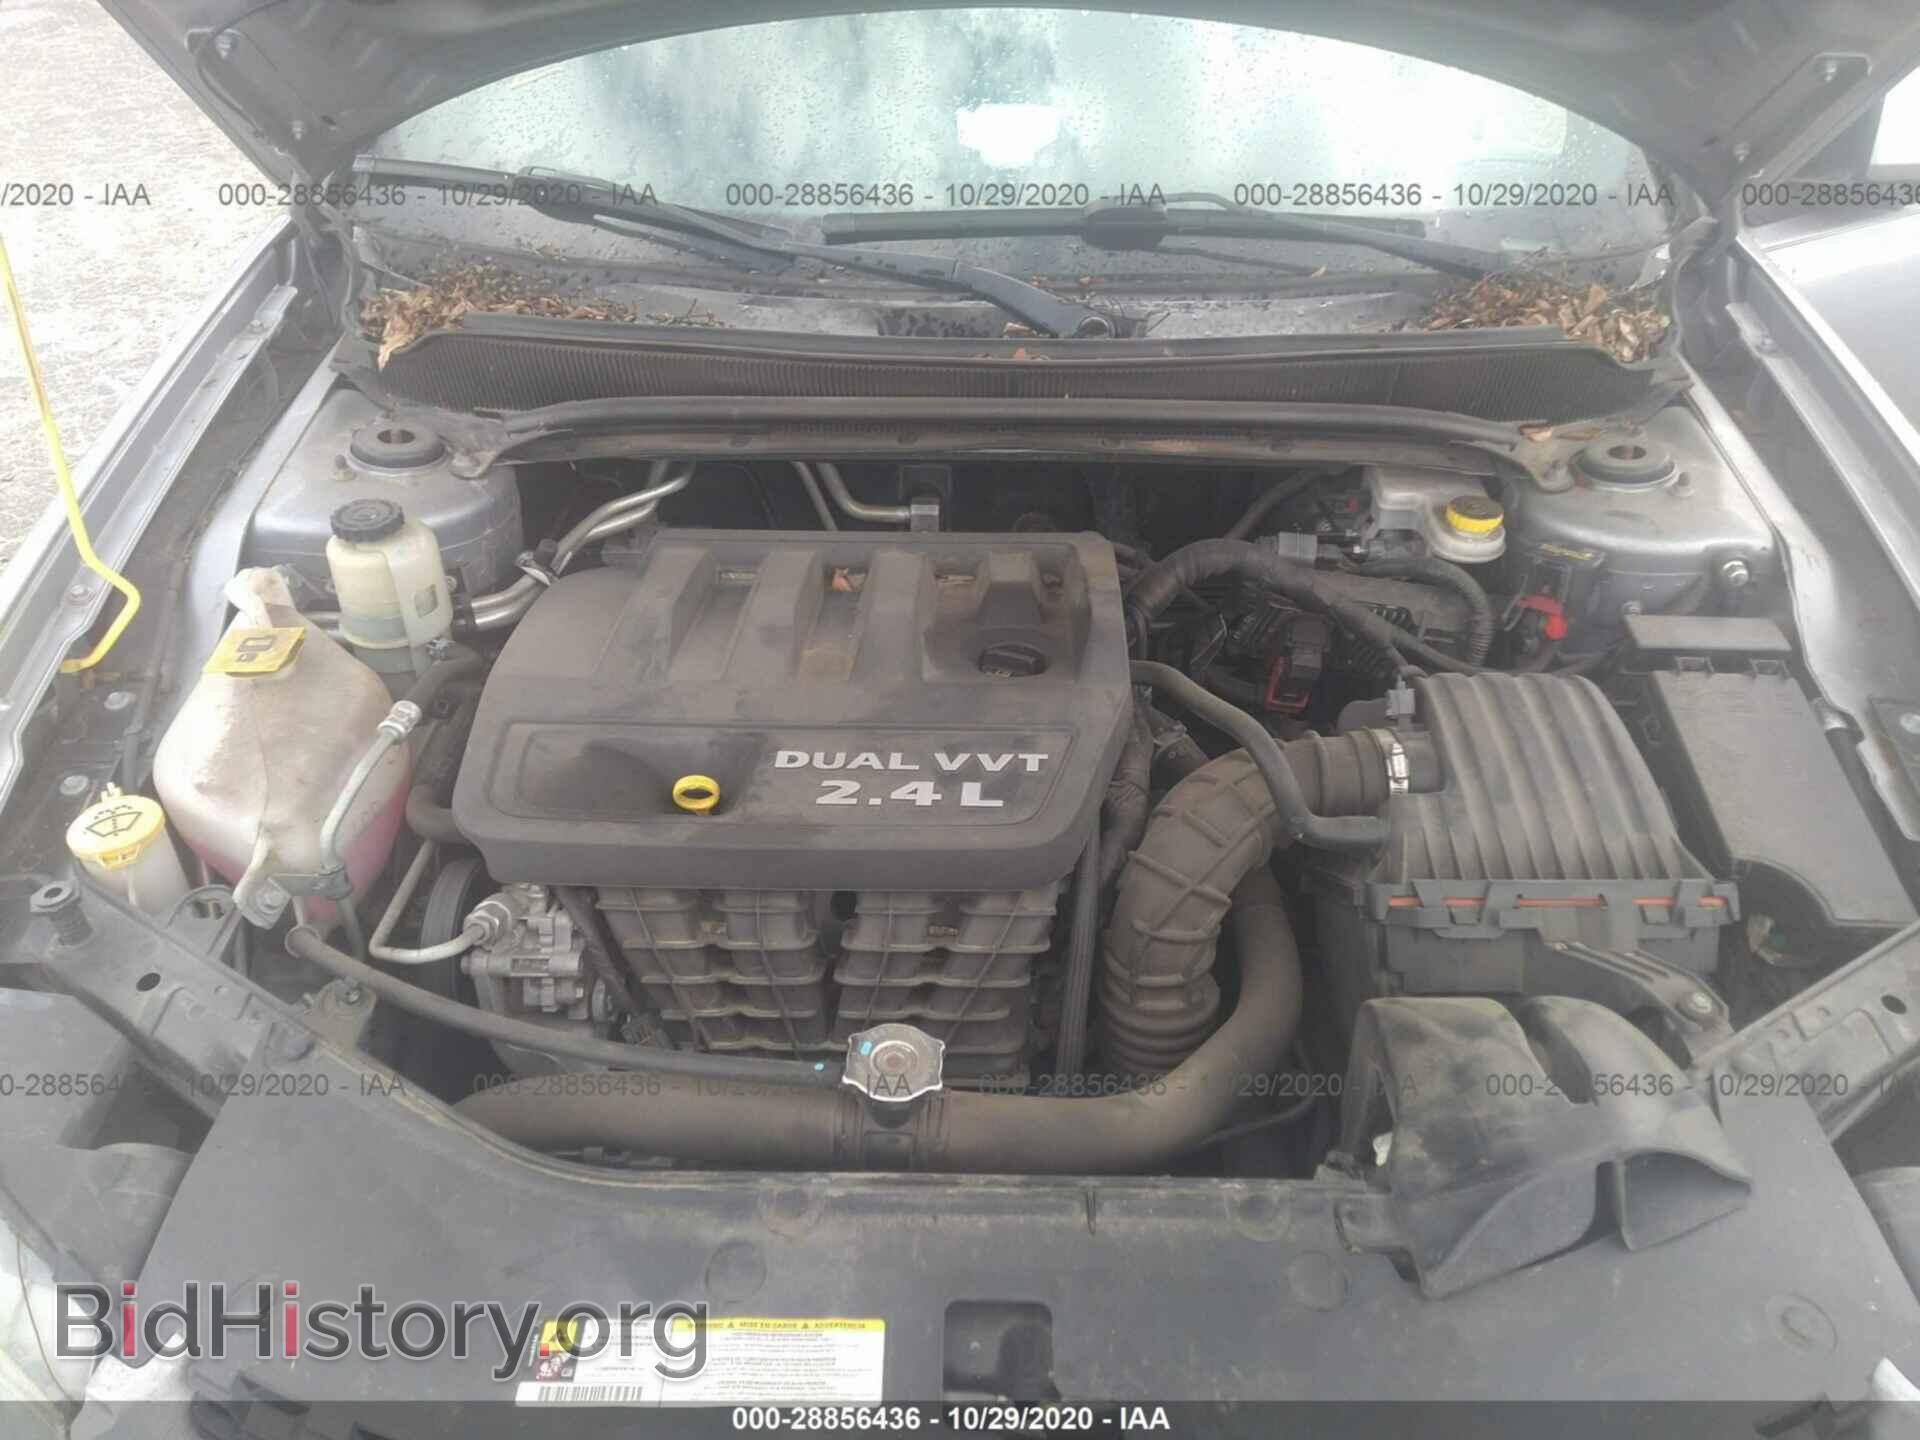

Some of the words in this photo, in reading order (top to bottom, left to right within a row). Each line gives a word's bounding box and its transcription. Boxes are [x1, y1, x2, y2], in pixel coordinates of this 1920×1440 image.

[775, 751, 920, 770] DUAL
[934, 753, 1048, 771] VVT
[960, 782, 1004, 806] L
